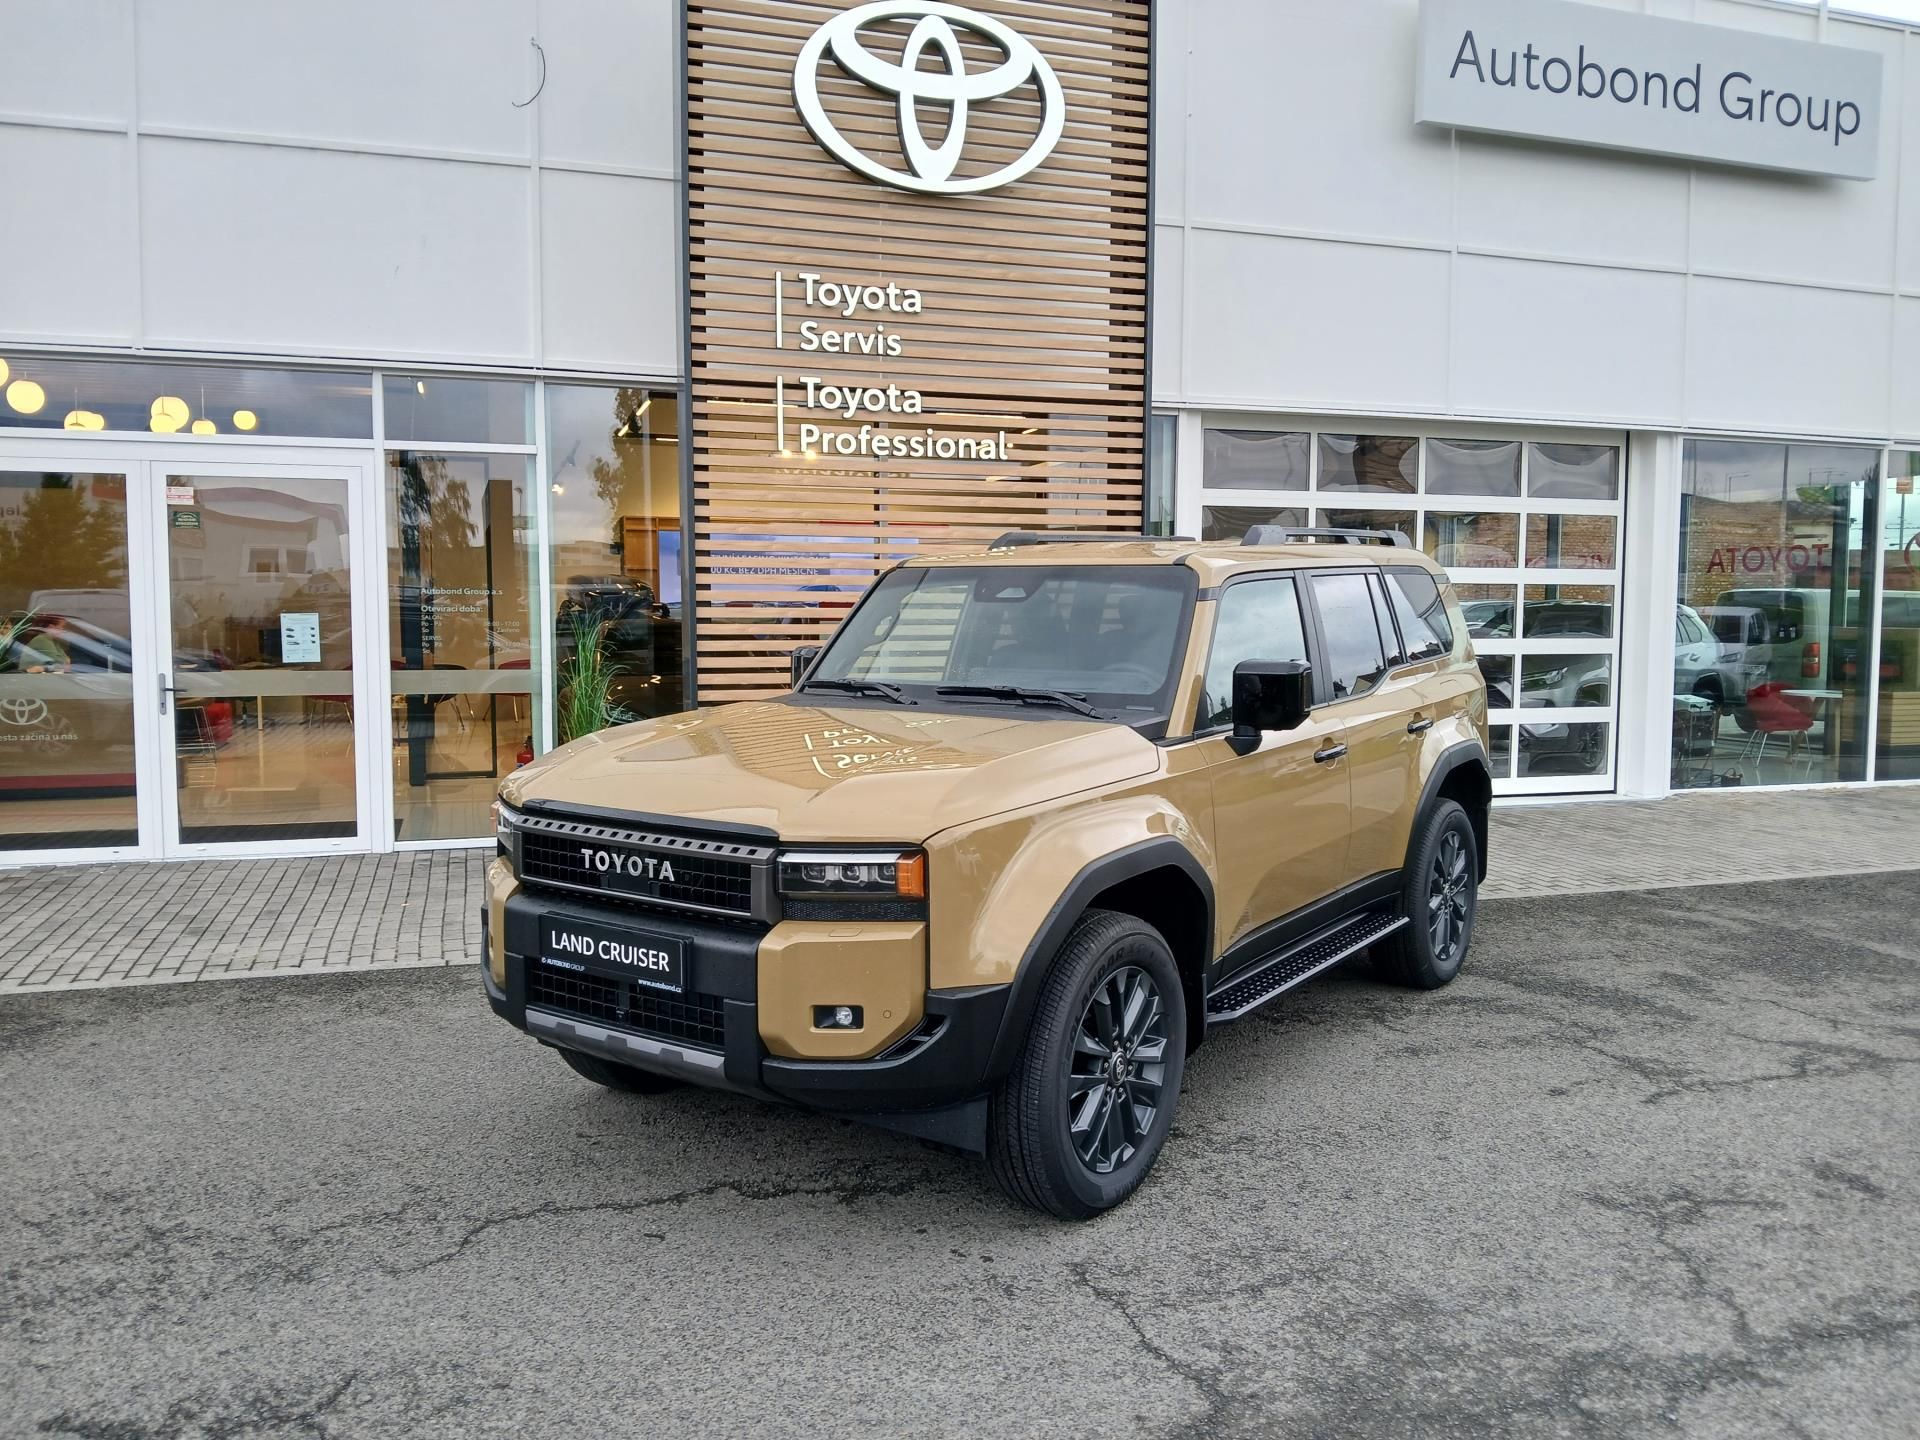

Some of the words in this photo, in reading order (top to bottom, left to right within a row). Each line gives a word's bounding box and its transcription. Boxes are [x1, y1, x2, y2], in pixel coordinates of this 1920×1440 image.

[1449, 29, 1702, 114] Autobond
[1719, 71, 1862, 146] Group
[798, 272, 922, 317] Toyota
[800, 320, 902, 356] Servis
[799, 376, 922, 419] Toyota
[800, 423, 1008, 460] Professional
[463, 588, 490, 597] Group
[580, 848, 675, 882] TOYOTA
[546, 958, 571, 969] AUTOBOND
[570, 963, 585, 972] GROUP
[551, 930, 595, 956] LAND
[598, 940, 670, 972] CRUISER
[638, 978, 682, 993] www.autobond.cz
